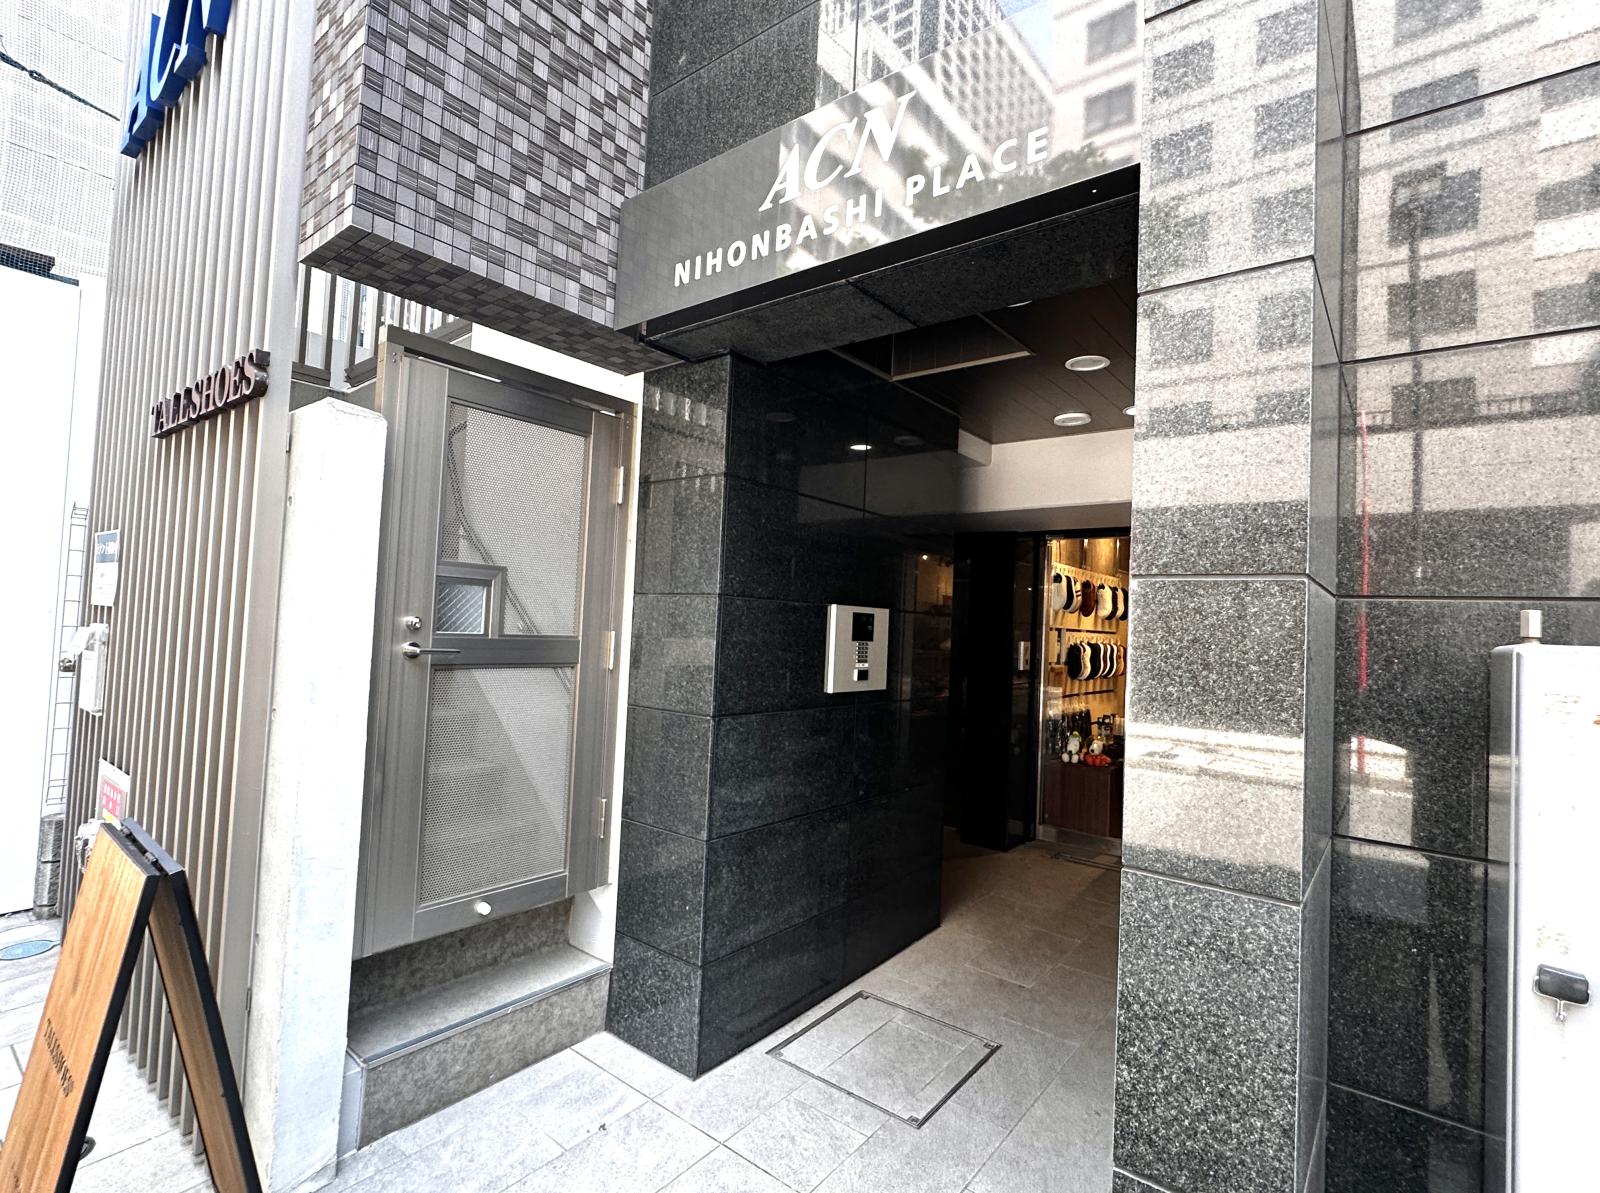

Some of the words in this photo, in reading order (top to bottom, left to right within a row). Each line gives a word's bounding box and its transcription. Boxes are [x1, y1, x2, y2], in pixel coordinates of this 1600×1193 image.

[673, 189, 883, 288] NIHONBASHI
[905, 126, 1050, 207] PLACE
[758, 90, 917, 212] ACN
